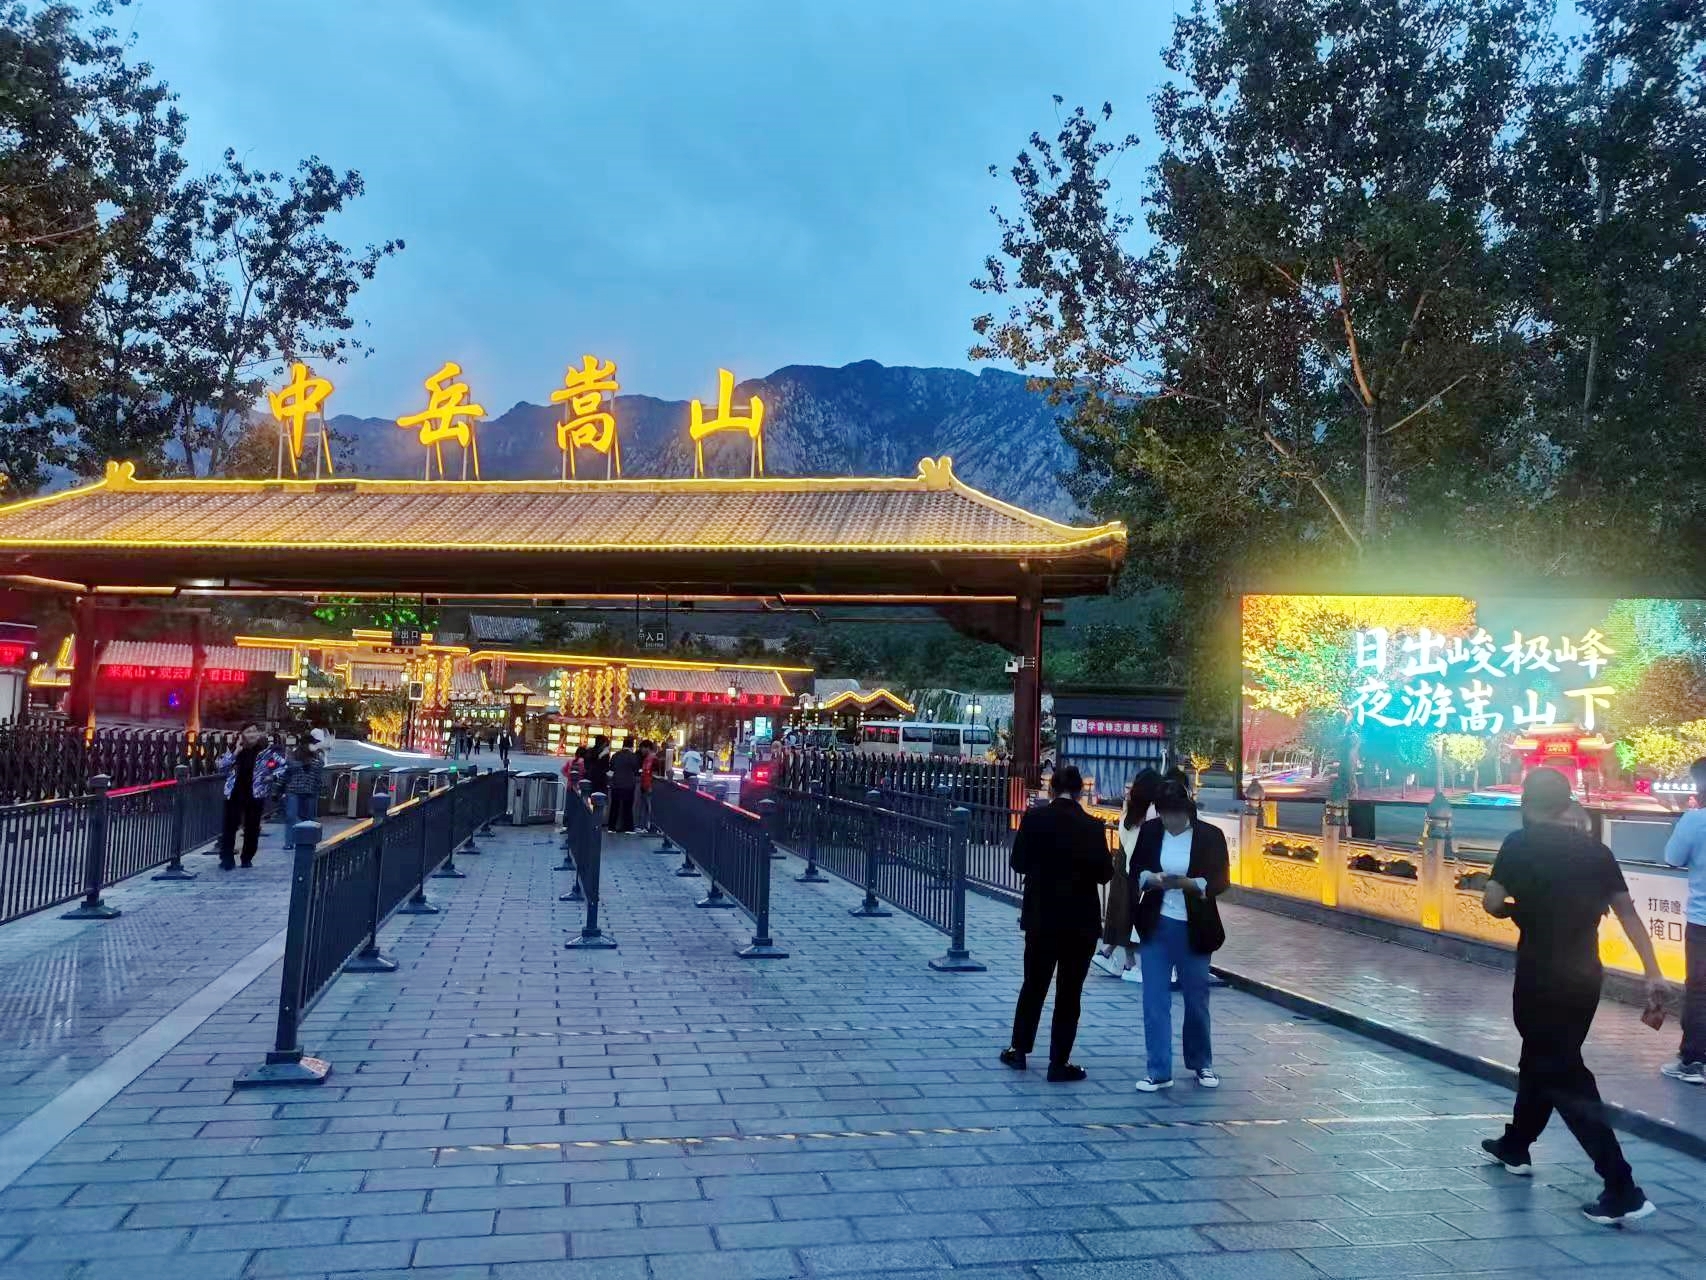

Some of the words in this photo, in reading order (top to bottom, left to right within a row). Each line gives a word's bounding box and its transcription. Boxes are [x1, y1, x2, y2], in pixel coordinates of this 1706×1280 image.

[268, 355, 764, 458] 中岳嵩山
[646, 632, 664, 641] 入口
[1353, 628, 1616, 678] 日出峻极峰
[1349, 677, 1616, 734] 夜游嵩山下
[1649, 917, 1682, 942] 掩口
